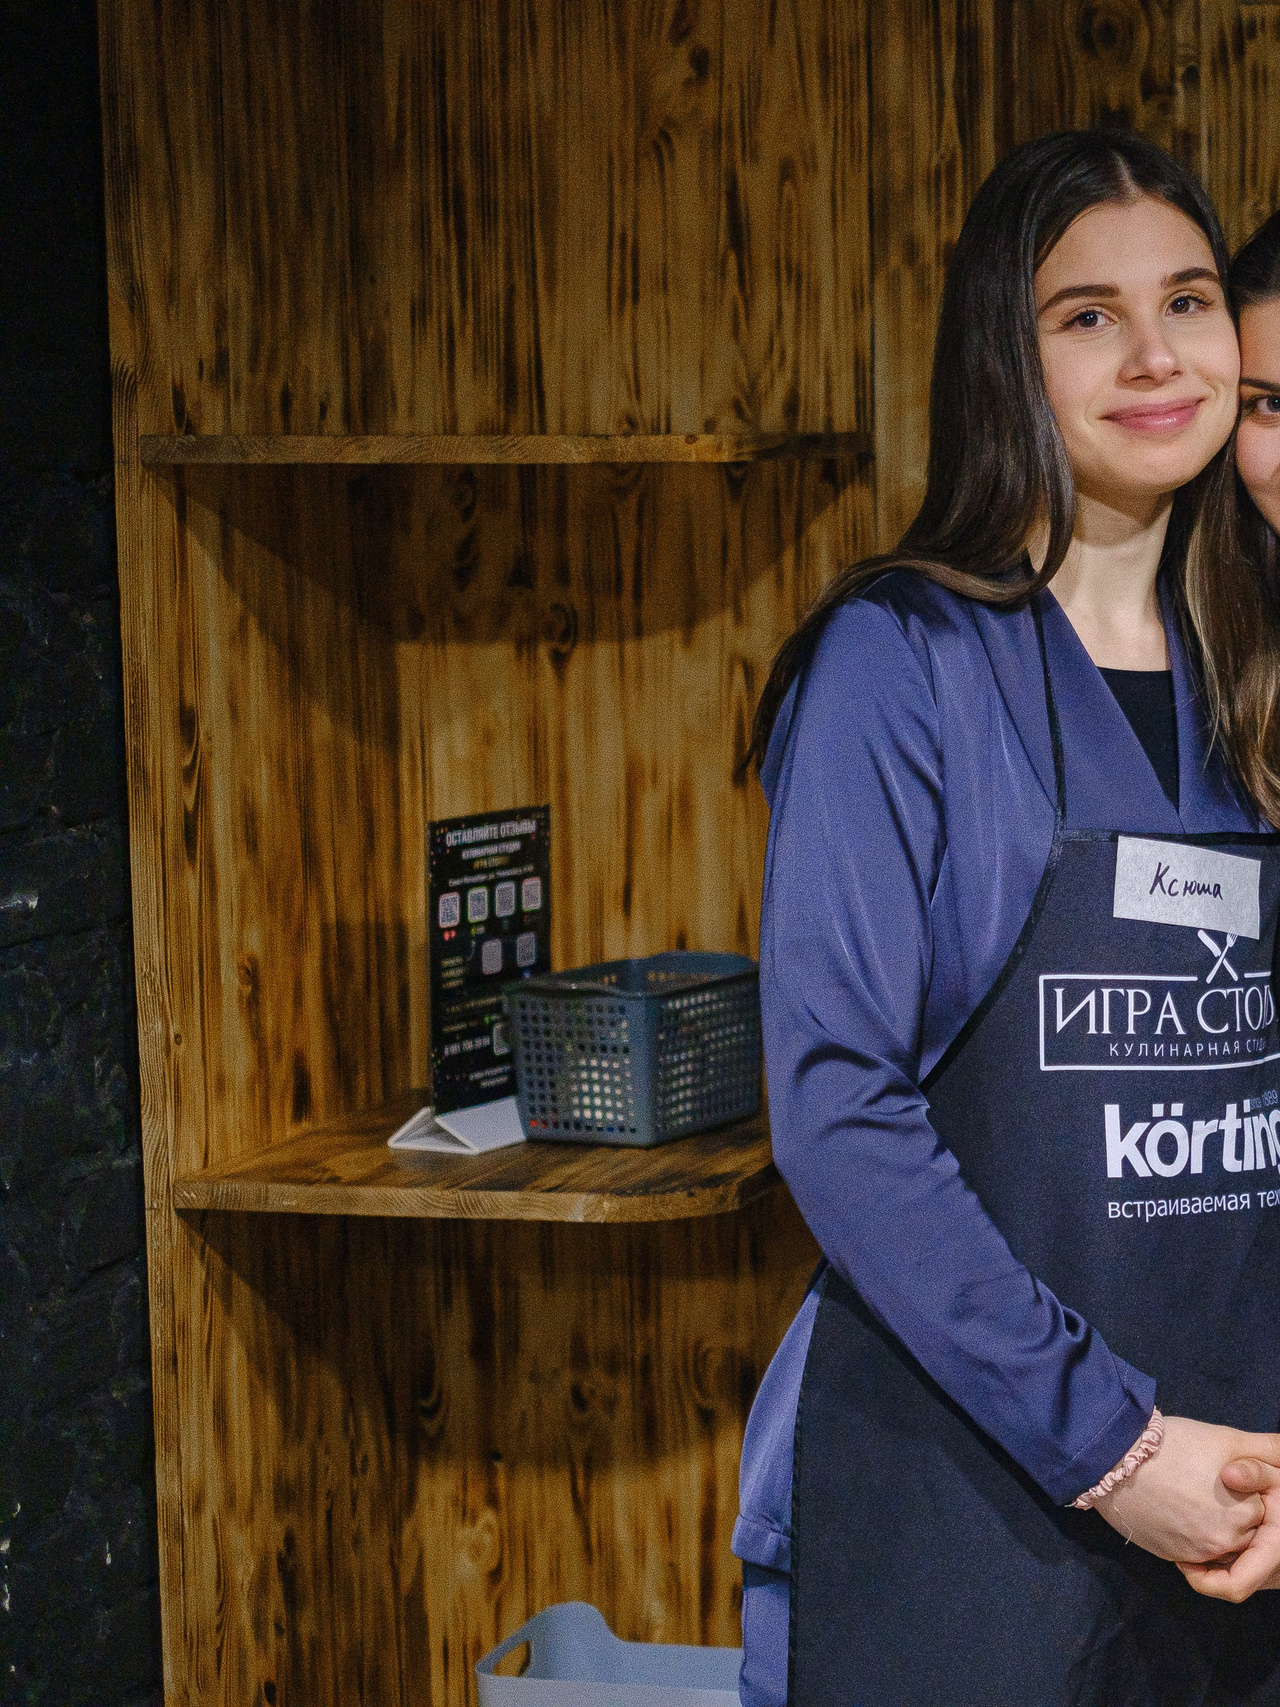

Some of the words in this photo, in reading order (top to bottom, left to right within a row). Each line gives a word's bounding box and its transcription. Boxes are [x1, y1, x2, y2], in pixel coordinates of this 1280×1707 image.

[1150, 862, 1223, 900] Ксюша
[1054, 987, 1187, 1035] ИГРА
[1109, 1040, 1240, 1057] КУЛИНАРНАЯ
[1108, 1191, 1250, 1223] встраиваемая
